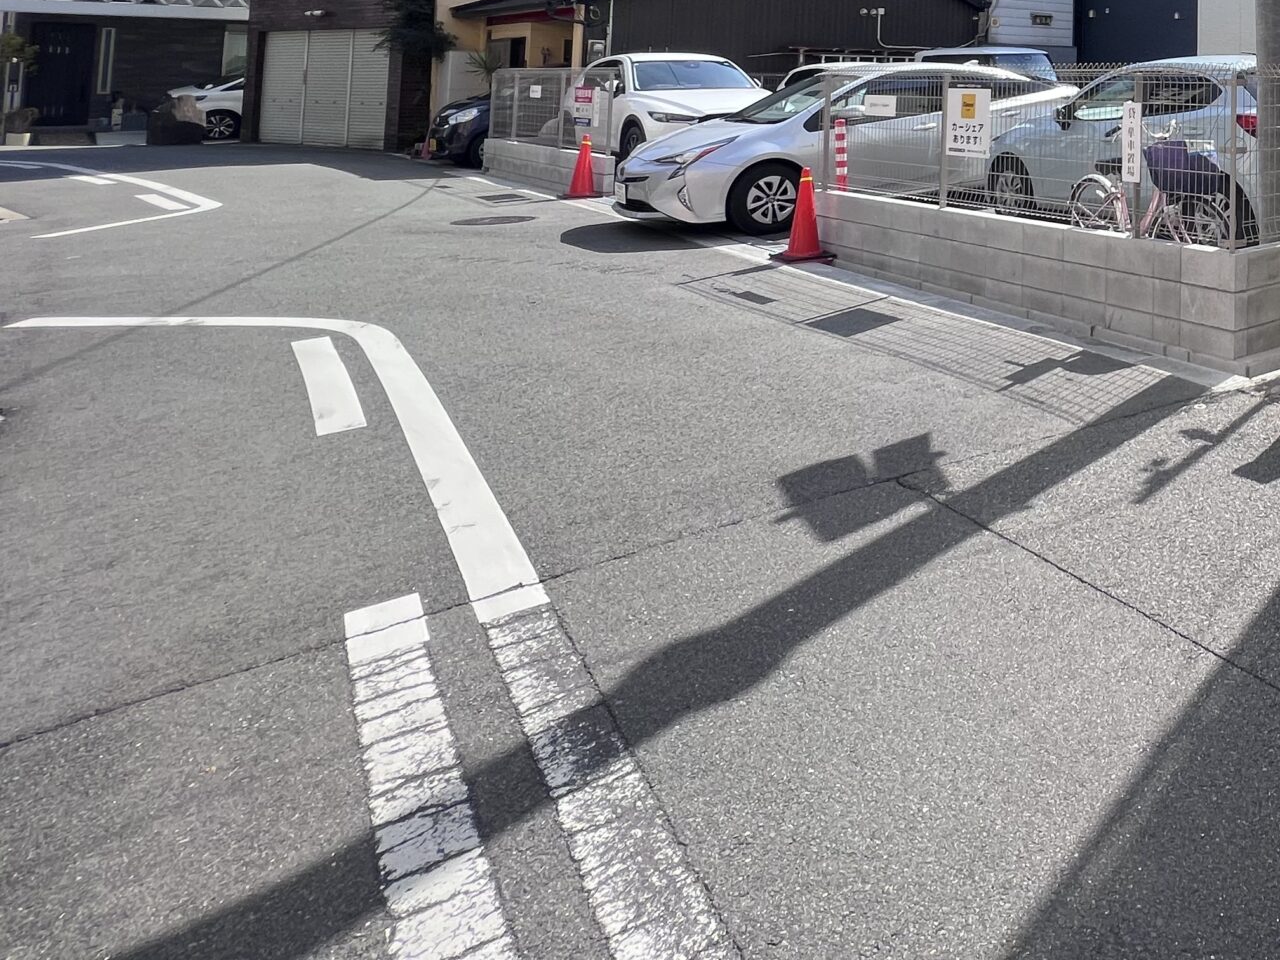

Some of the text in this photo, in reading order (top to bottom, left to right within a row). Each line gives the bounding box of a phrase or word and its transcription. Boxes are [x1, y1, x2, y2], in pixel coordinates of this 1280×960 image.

[951, 122, 984, 133] カーシェア
[952, 134, 983, 146] あります!
